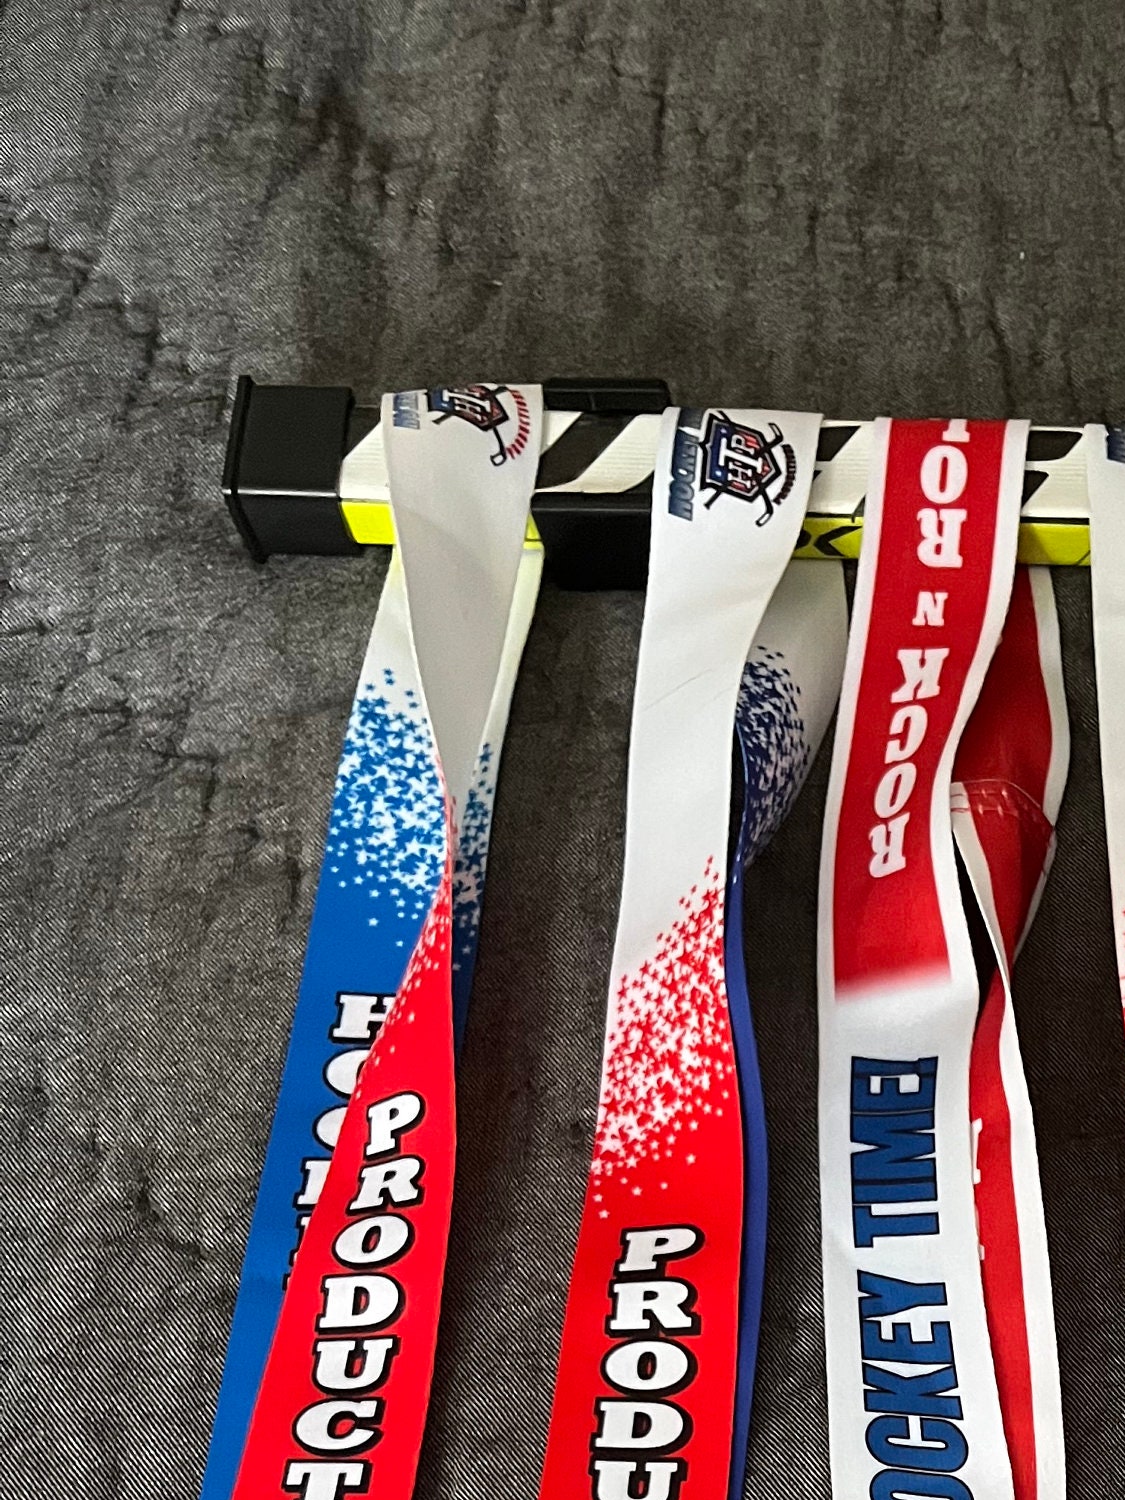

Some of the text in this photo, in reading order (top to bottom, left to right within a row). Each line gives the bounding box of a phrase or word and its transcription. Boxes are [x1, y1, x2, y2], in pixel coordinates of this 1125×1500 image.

[868, 647, 950, 879] ROCK
[911, 590, 949, 627] N
[850, 1055, 941, 1250] TIME!
